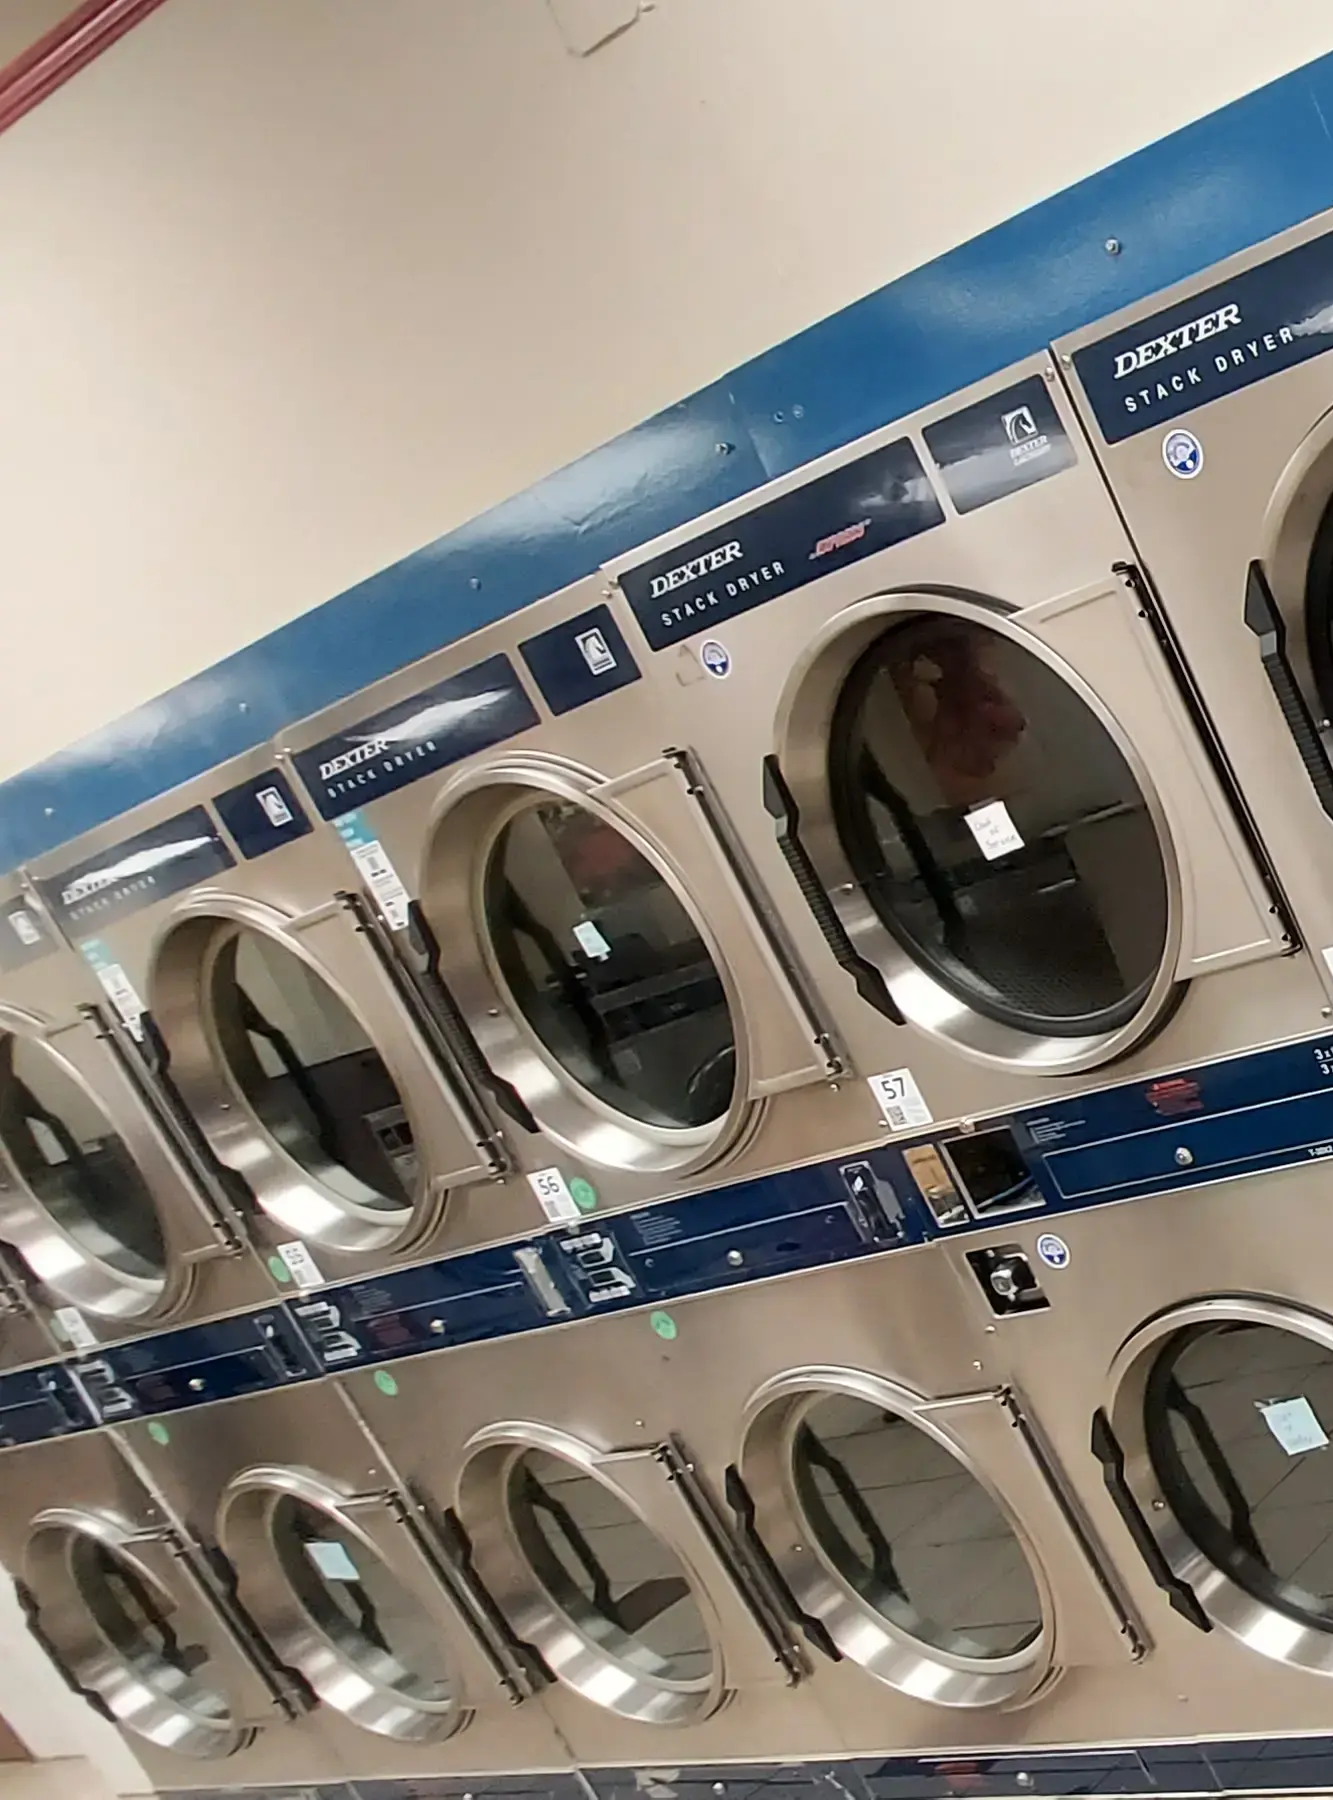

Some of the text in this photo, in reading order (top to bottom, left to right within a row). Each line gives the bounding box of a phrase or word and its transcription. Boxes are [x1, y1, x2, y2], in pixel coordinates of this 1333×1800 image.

[1113, 303, 1242, 379] DEXTER
[1125, 326, 1294, 413] STACK DRYER
[650, 540, 744, 599] DEXTER
[661, 561, 786, 627] STACK DRYER
[318, 739, 390, 780] DEXTER
[881, 1076, 905, 1100] 57
[537, 1175, 560, 1196] 56
